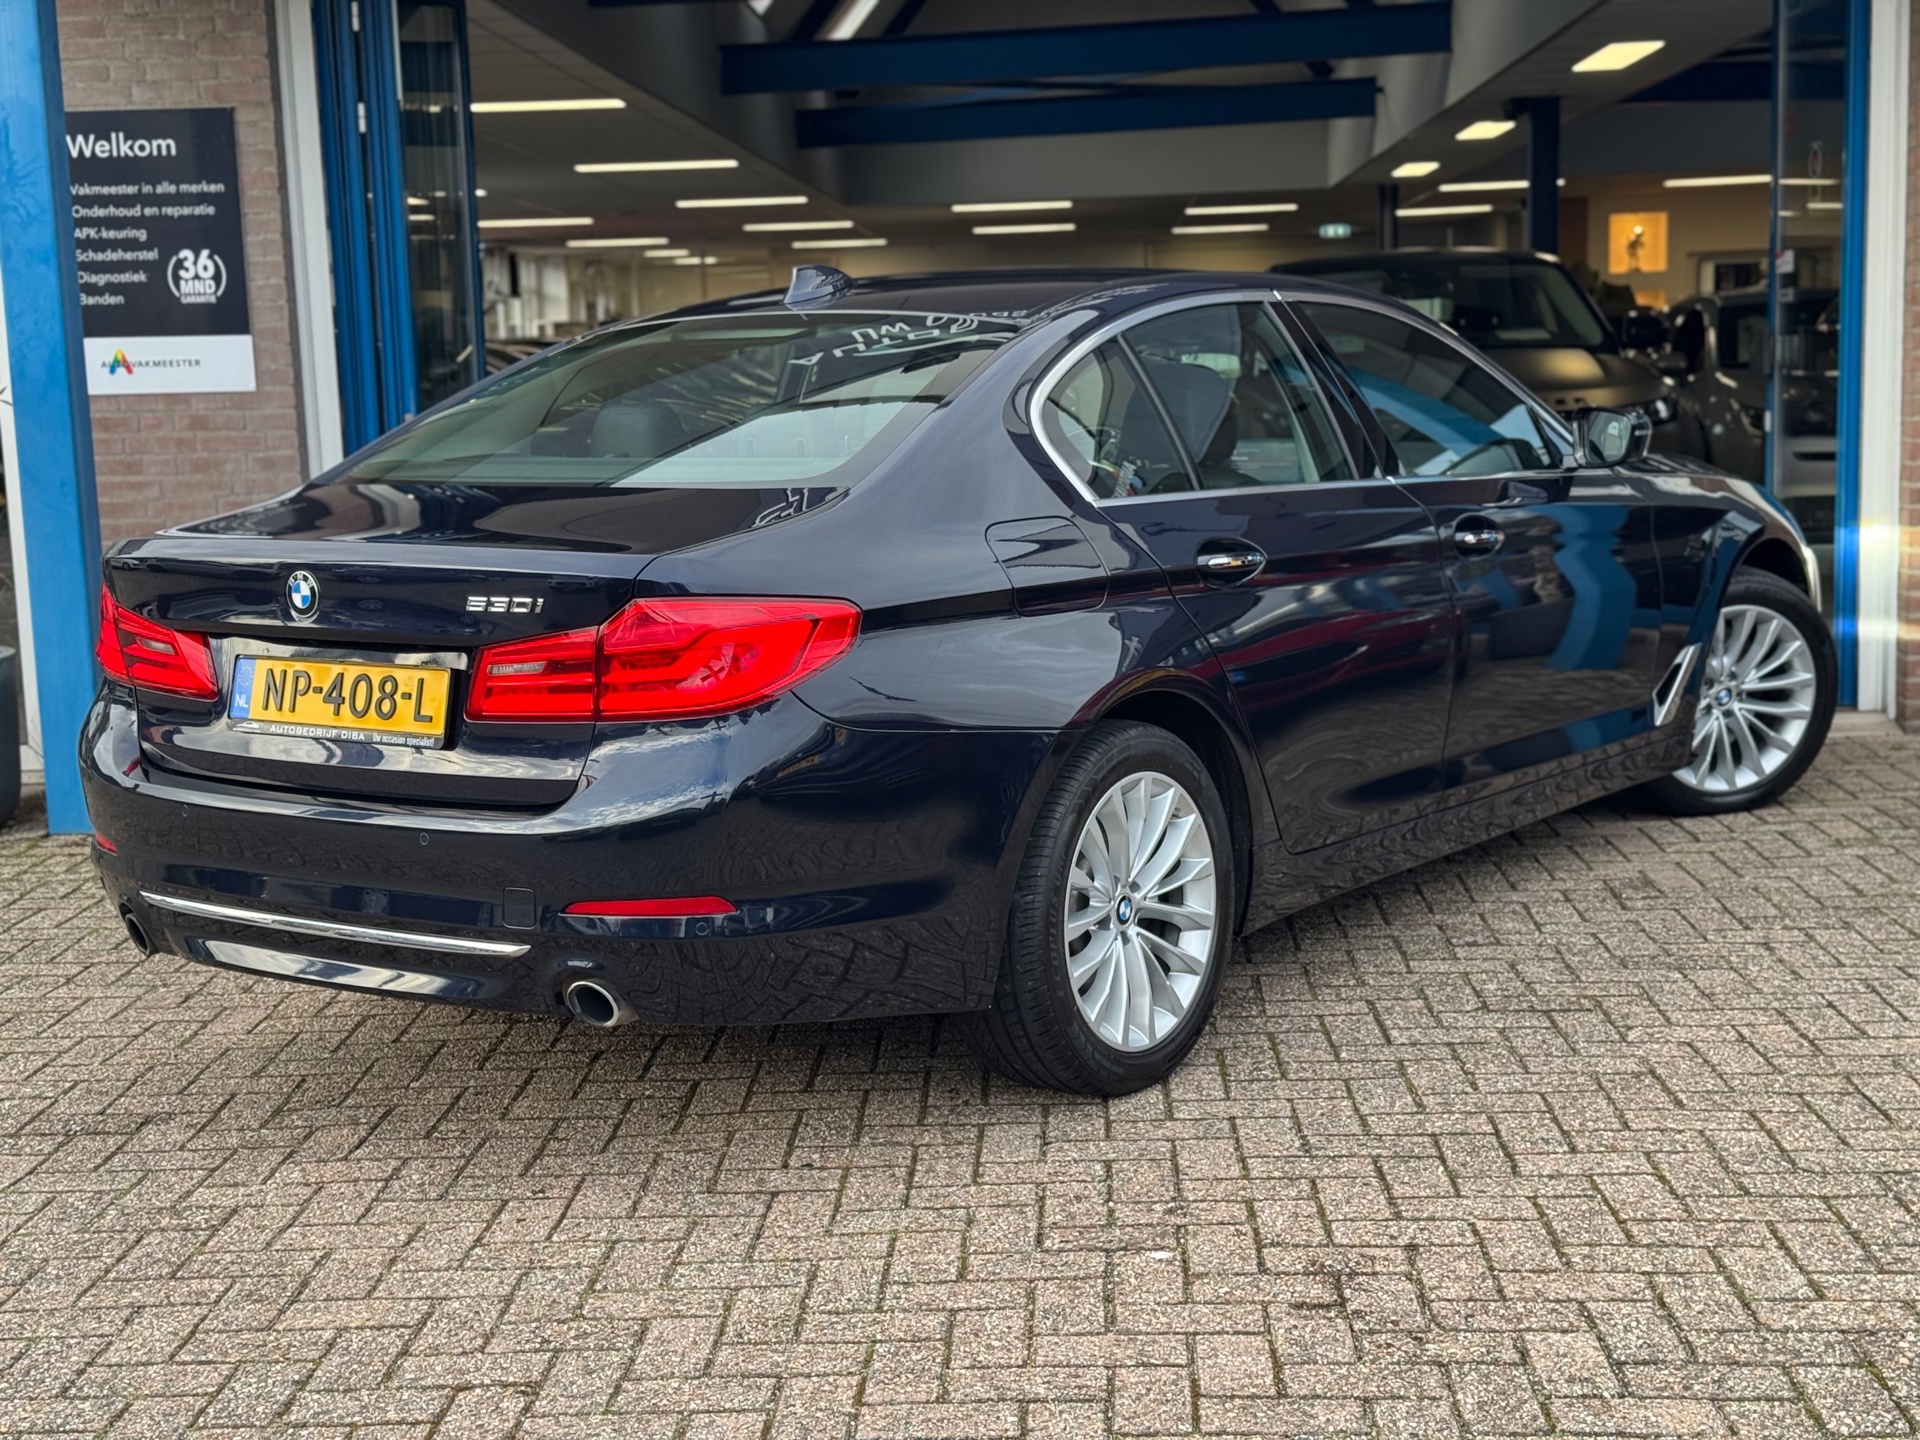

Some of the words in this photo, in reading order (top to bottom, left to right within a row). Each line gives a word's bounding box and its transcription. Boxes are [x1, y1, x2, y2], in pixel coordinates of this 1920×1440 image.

[65, 131, 177, 158] Welkom
[70, 182, 139, 196] Vakmeester
[141, 182, 153, 194] in
[155, 181, 177, 194] alle
[179, 180, 225, 193] merken
[72, 203, 141, 218] Onderhoud
[143, 206, 159, 216] en
[161, 203, 216, 219] reparatie
[74, 226, 147, 242] APK-keuring
[75, 247, 159, 262] Schadeherstel
[178, 249, 215, 279] 36
[77, 269, 148, 286] Diagnostiek
[180, 279, 216, 294] MND
[79, 292, 125, 306] Banden
[465, 595, 545, 614] 530i
[234, 693, 249, 708] NL
[261, 667, 433, 723] NP-408-L
[269, 724, 338, 739] AUTOBEDRIJF
[340, 730, 366, 741] DIBA
[372, 732, 382, 742] Uw
[382, 734, 406, 746] occasion
